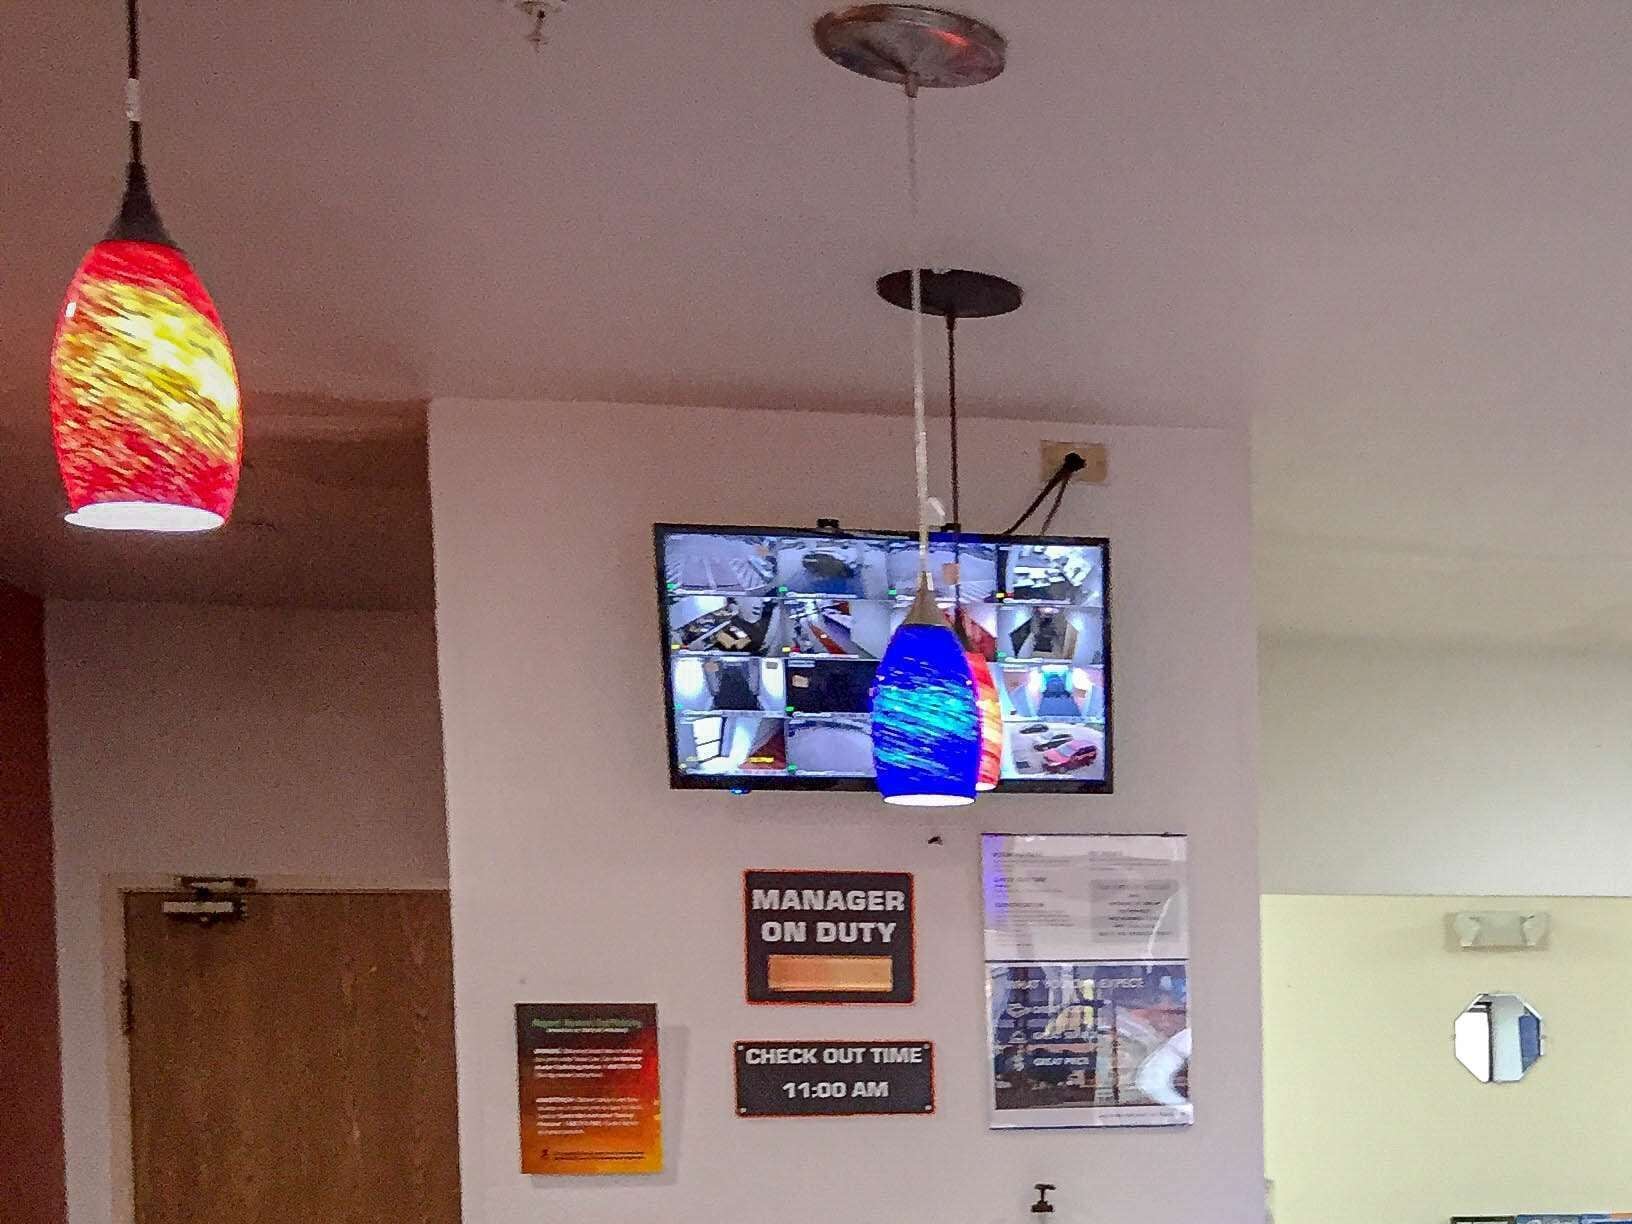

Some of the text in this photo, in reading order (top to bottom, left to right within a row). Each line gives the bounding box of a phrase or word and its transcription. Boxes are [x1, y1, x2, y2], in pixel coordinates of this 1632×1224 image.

[752, 889, 905, 911] MANAGER
[761, 921, 896, 943] ON DUTY
[745, 1047, 923, 1065] CHECK OUT TIME
[782, 1081, 889, 1098] 11:00 AM
